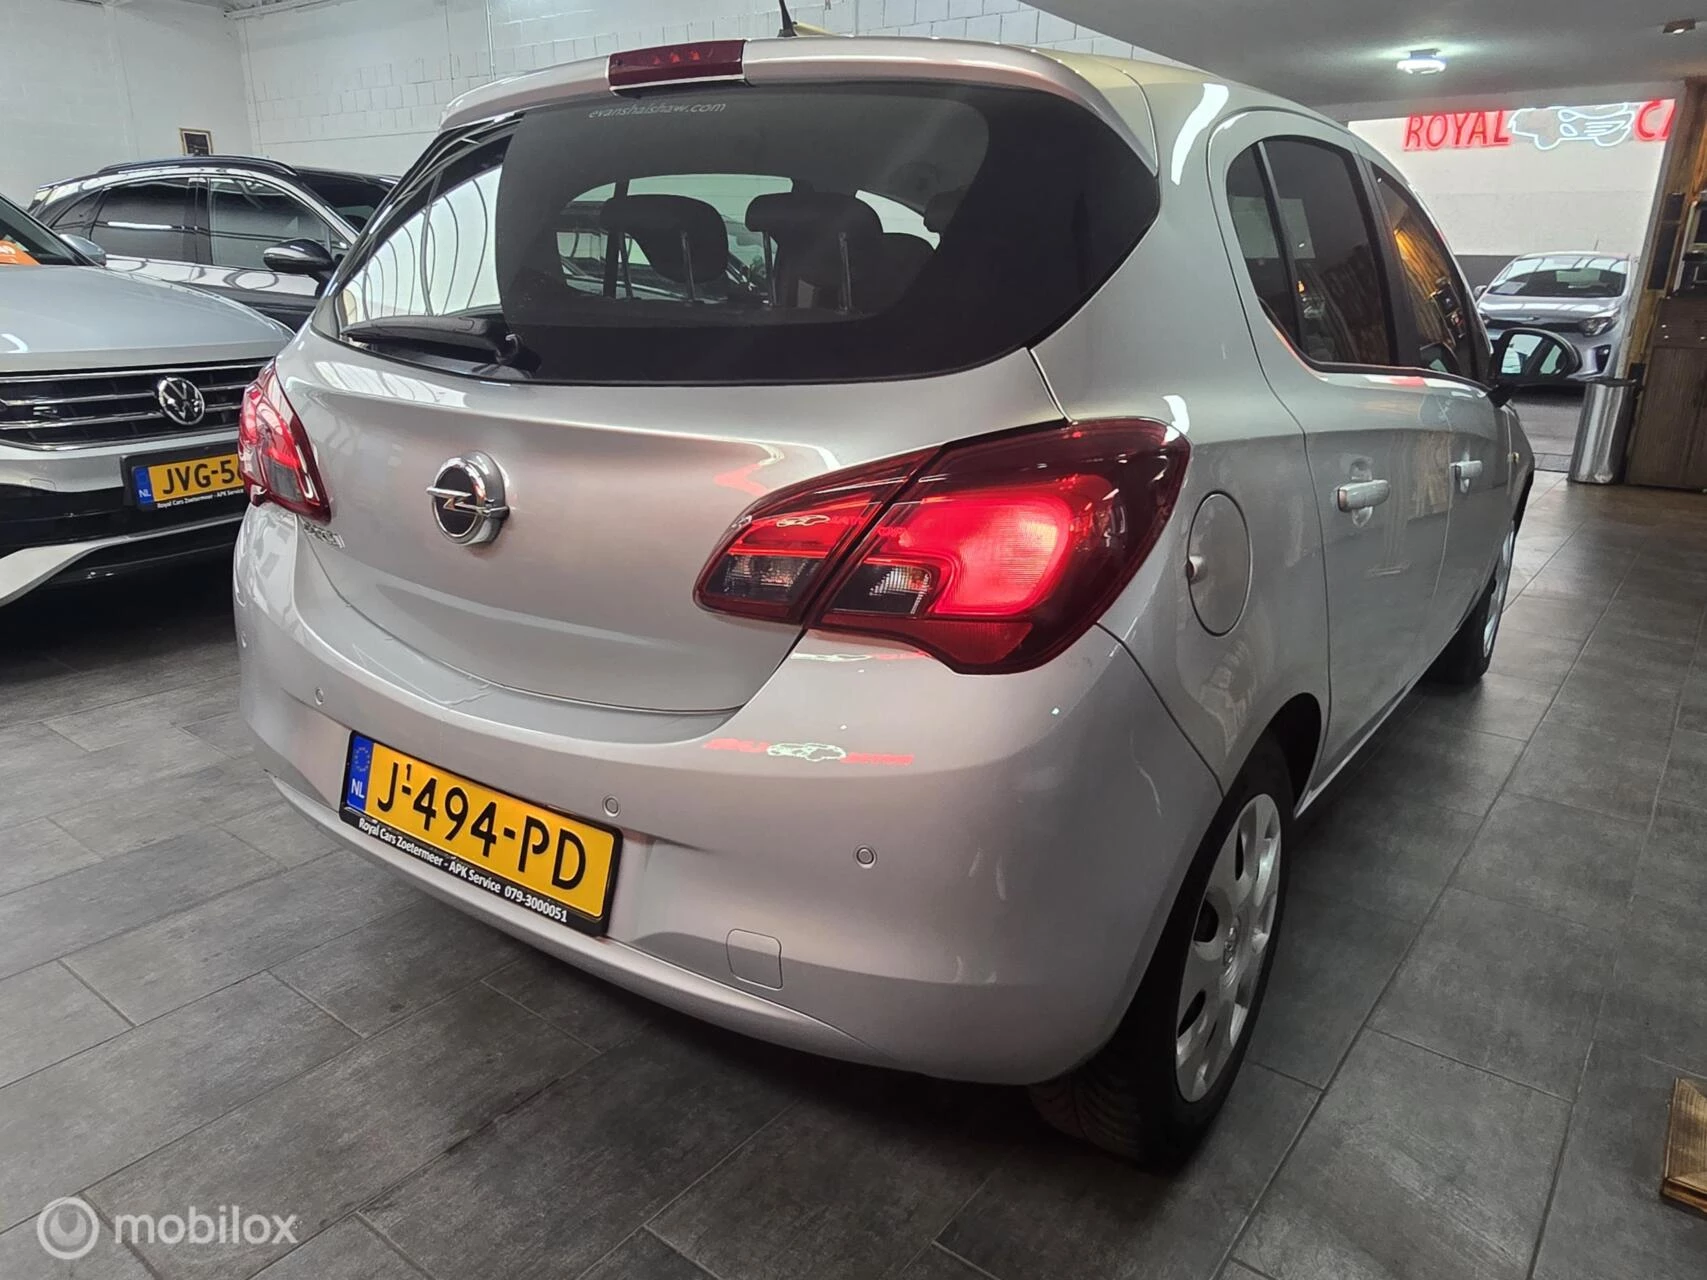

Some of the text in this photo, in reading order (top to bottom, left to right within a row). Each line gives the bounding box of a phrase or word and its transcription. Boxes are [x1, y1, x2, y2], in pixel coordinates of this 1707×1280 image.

[1404, 110, 1510, 149] ROYAL
[138, 488, 151, 498] NL
[350, 778, 365, 799] NL
[377, 762, 586, 890] J-494-PD
[358, 817, 380, 837] Royal
[380, 828, 397, 844] Cars
[396, 836, 444, 866] Zoetermeer
[448, 861, 468, 878] APK
[468, 869, 502, 893] Service
[504, 885, 567, 922] 079-3000051
